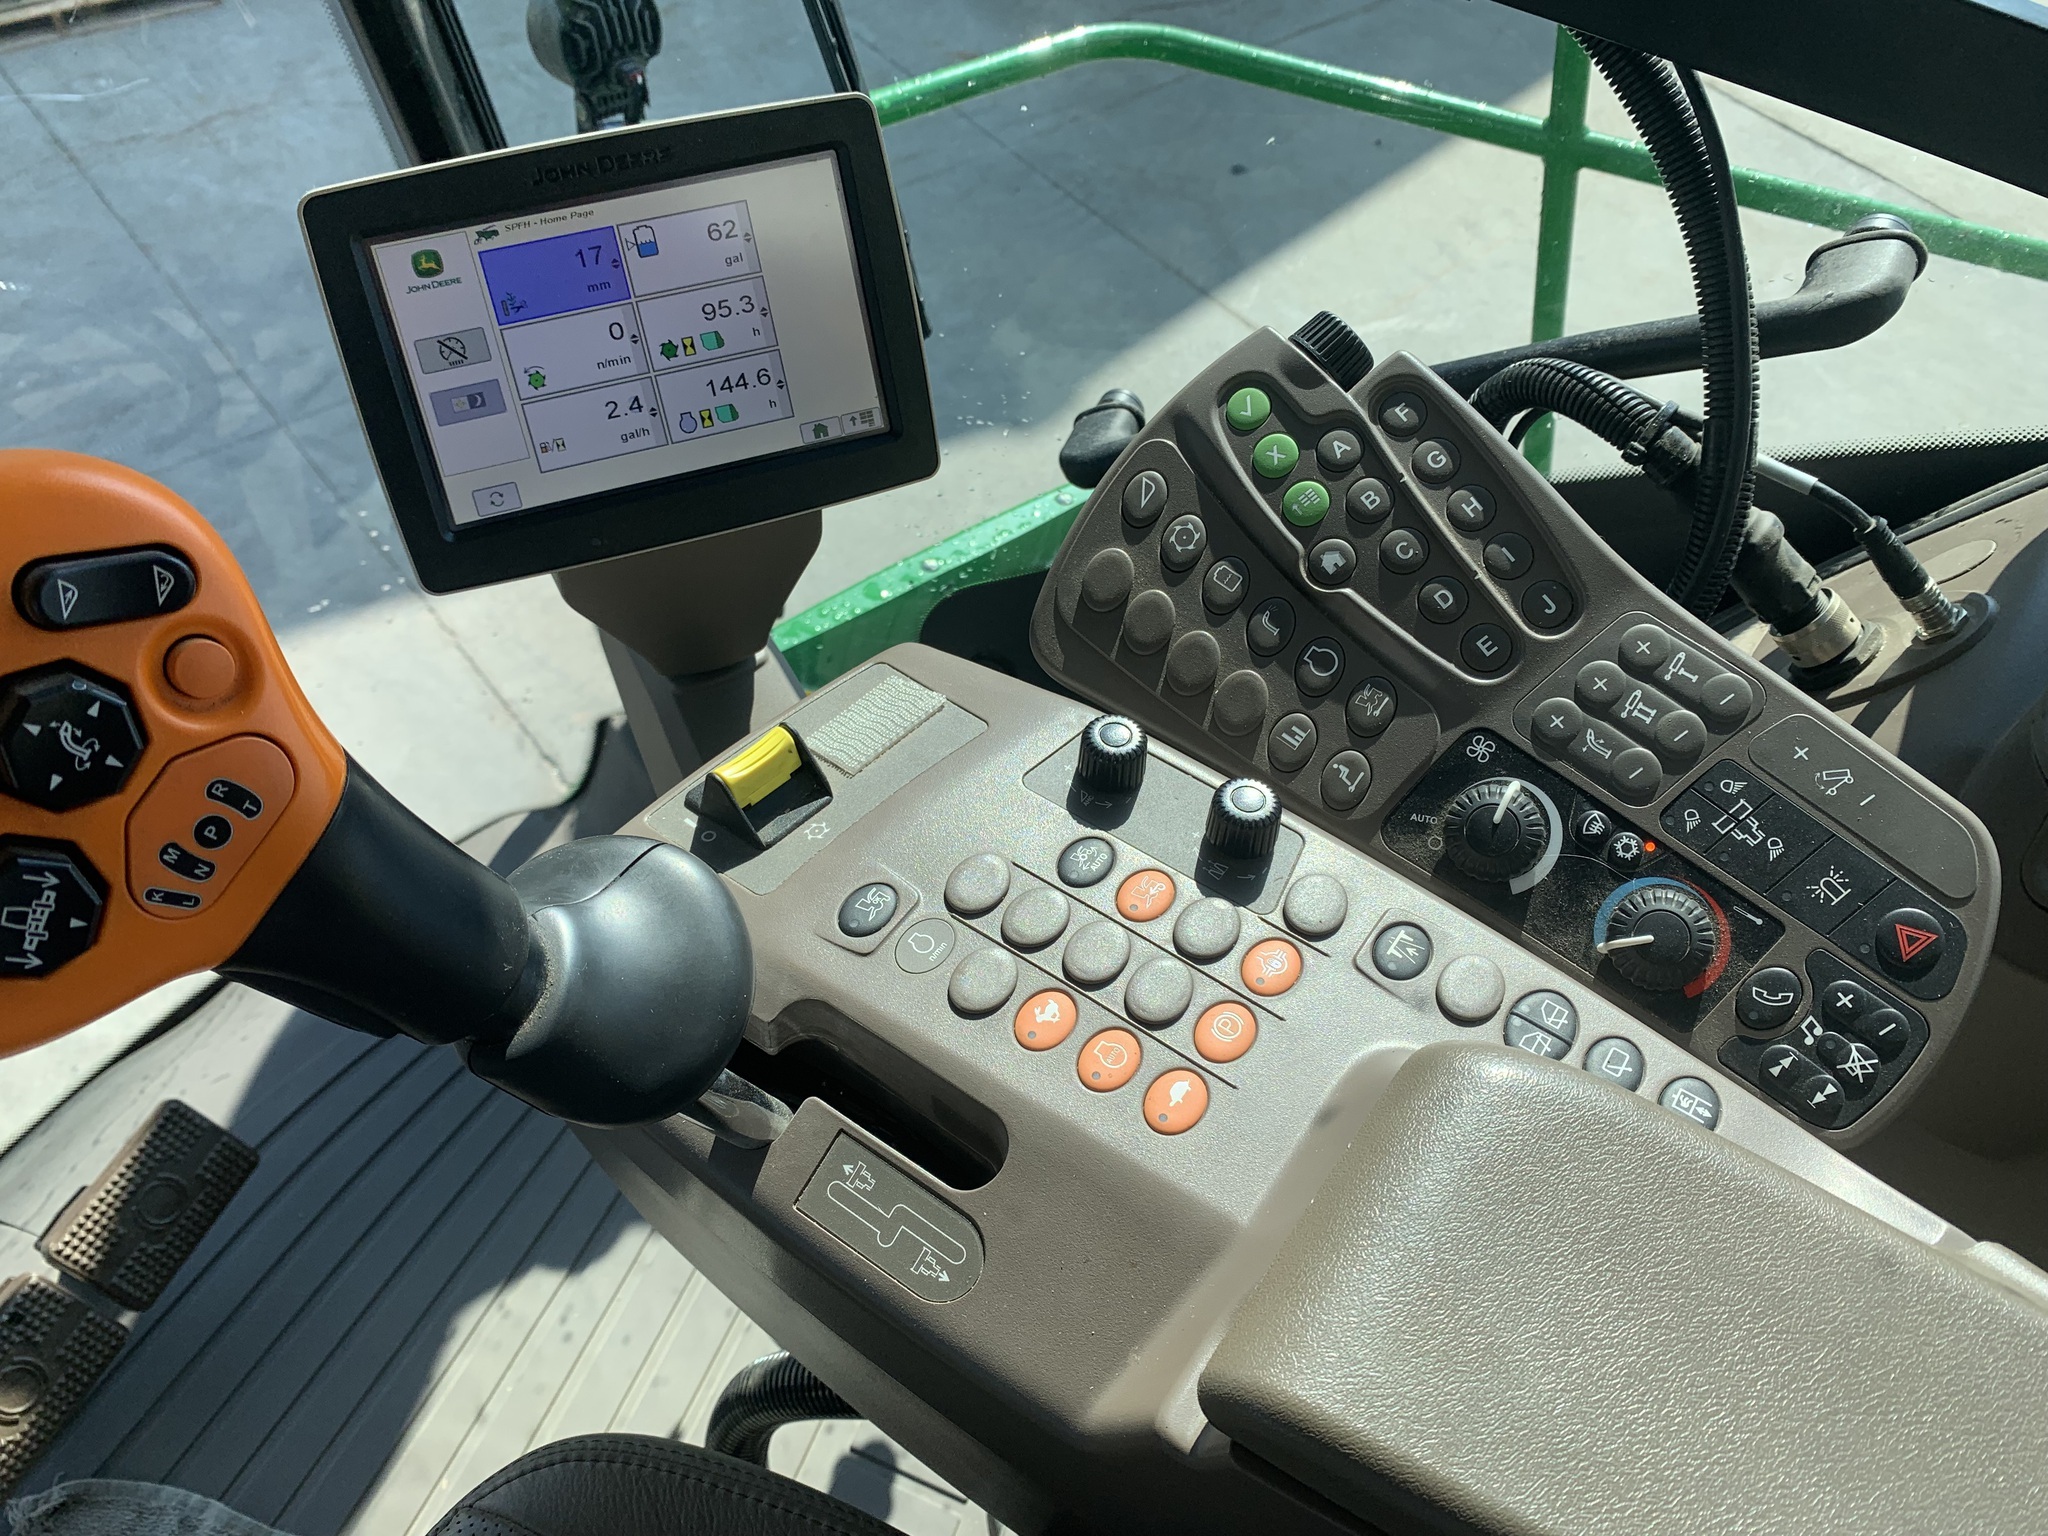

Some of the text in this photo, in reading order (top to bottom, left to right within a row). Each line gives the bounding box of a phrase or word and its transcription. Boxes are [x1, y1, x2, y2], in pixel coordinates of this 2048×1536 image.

[504, 220, 531, 233] SPFH
[540, 215, 568, 226] Home
[570, 209, 595, 220] Page
[706, 219, 739, 242] 62
[574, 245, 603, 269] 17
[724, 252, 744, 268] gal
[406, 276, 463, 295] JOHN DEERE
[587, 279, 612, 293] mm
[701, 294, 756, 322] 95.3
[608, 321, 625, 341] 0
[752, 326, 762, 338] h
[596, 354, 632, 371] n/min
[706, 368, 772, 398] 144.6
[604, 395, 644, 421] 2.4
[769, 399, 778, 410] h
[1394, 402, 1410, 423] F
[620, 426, 651, 444] gal/h
[1332, 440, 1352, 460] A
[1426, 450, 1447, 469] G
[1359, 490, 1381, 511] B
[1461, 496, 1484, 518] H
[1395, 541, 1414, 560] C
[1501, 546, 1516, 563] I
[1433, 589, 1454, 610] D
[1541, 594, 1557, 614] J
[1475, 634, 1499, 657] E
[211, 783, 229, 798] R
[243, 799, 258, 812] T
[1409, 813, 1438, 825] AUTO
[203, 825, 218, 840] P
[162, 847, 182, 864] M
[1090, 853, 1108, 872] AUTO
[193, 863, 211, 877] N
[151, 891, 165, 902] K
[182, 898, 195, 906] L
[928, 941, 949, 962] n/min
[1217, 1018, 1235, 1035] P
[1106, 1047, 1121, 1064] AUTO
